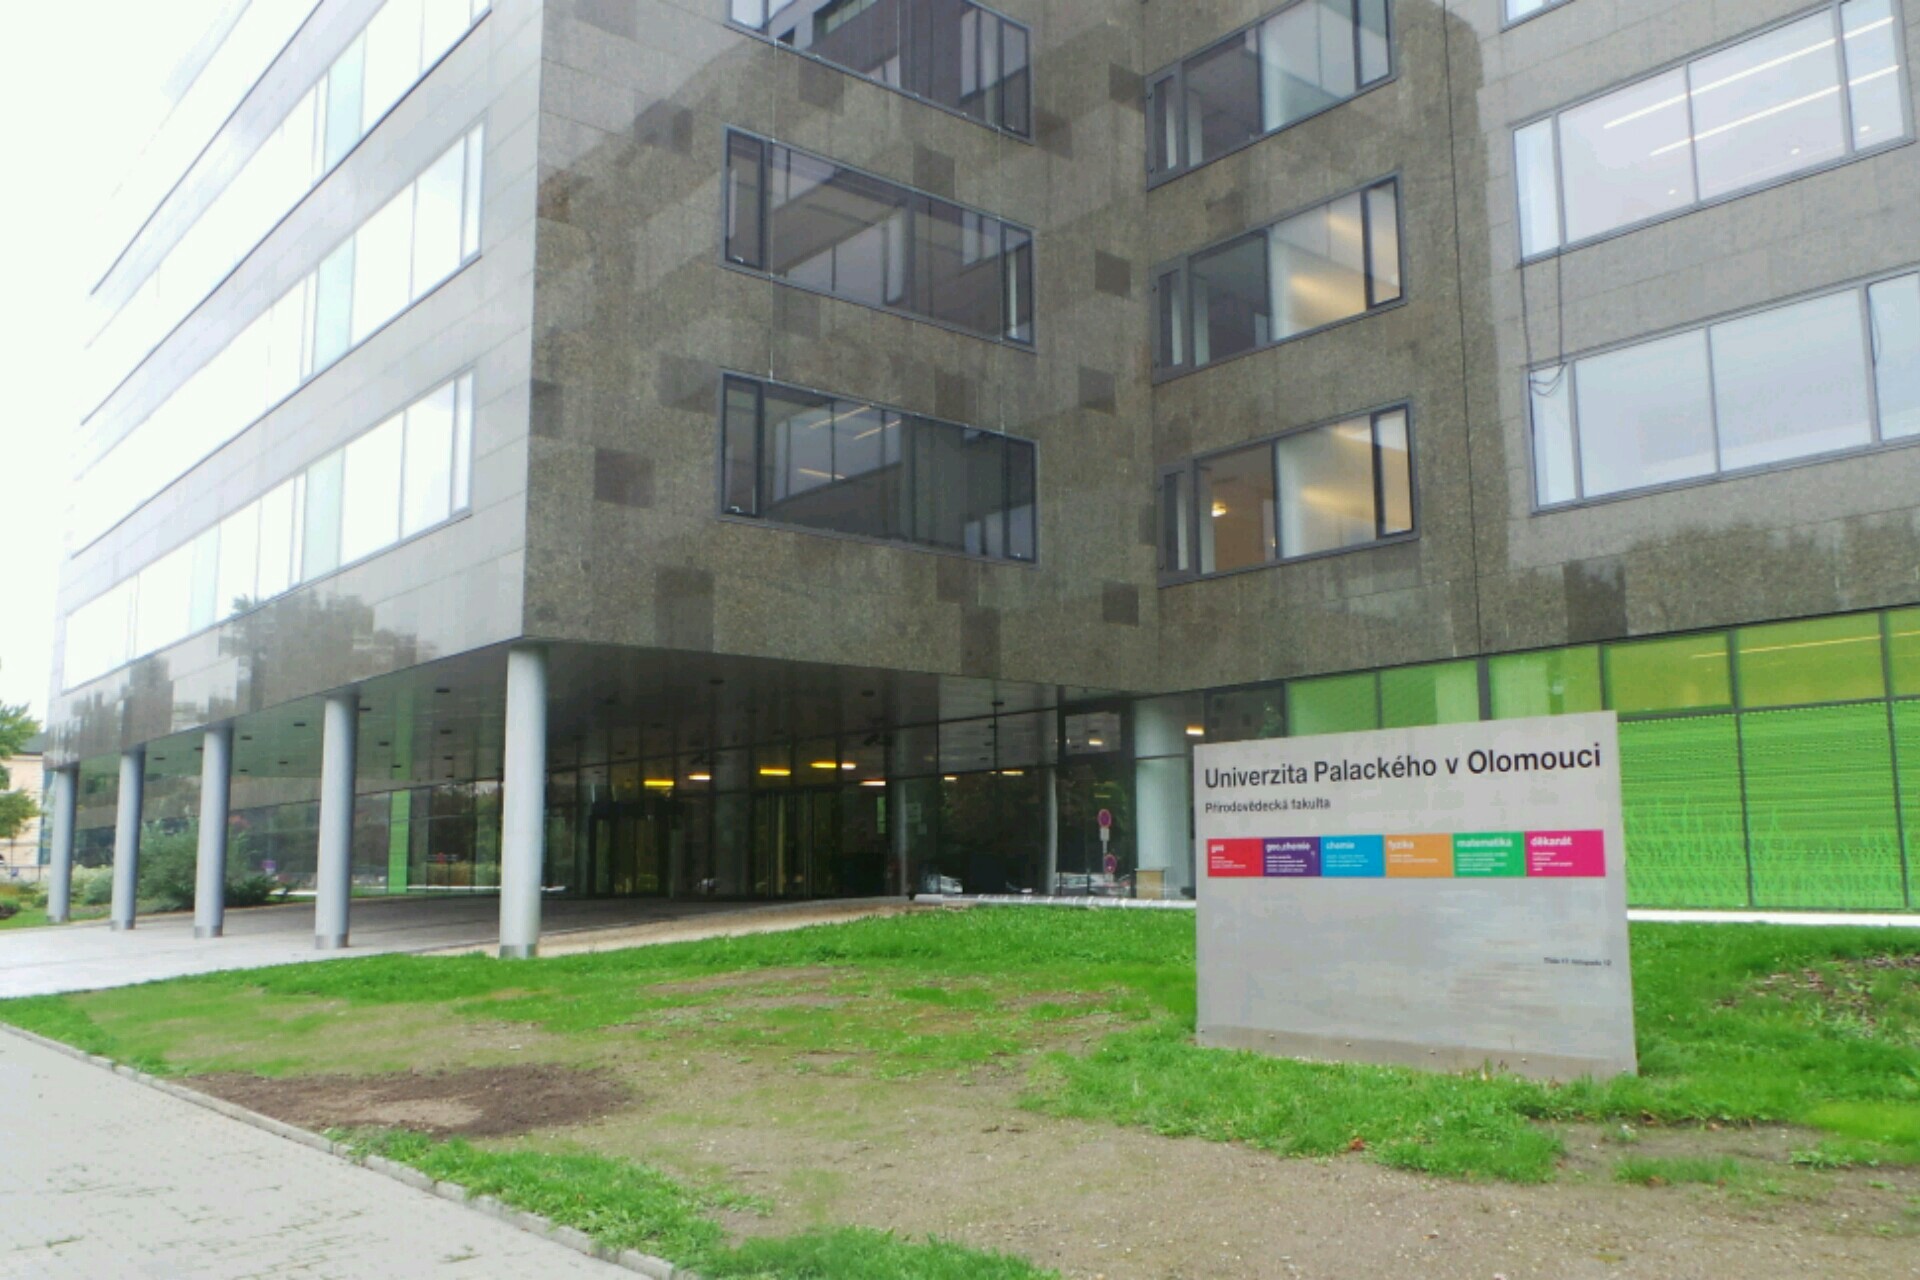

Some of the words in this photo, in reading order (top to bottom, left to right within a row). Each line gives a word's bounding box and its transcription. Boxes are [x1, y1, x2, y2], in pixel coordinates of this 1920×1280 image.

[1205, 763, 1308, 788] Univerzita
[1315, 756, 1437, 783] Palackého
[1446, 757, 1459, 774] v
[1468, 742, 1601, 774] Olomouci
[1290, 796, 1331, 811] fakulta
[1530, 836, 1573, 846] děkanát
